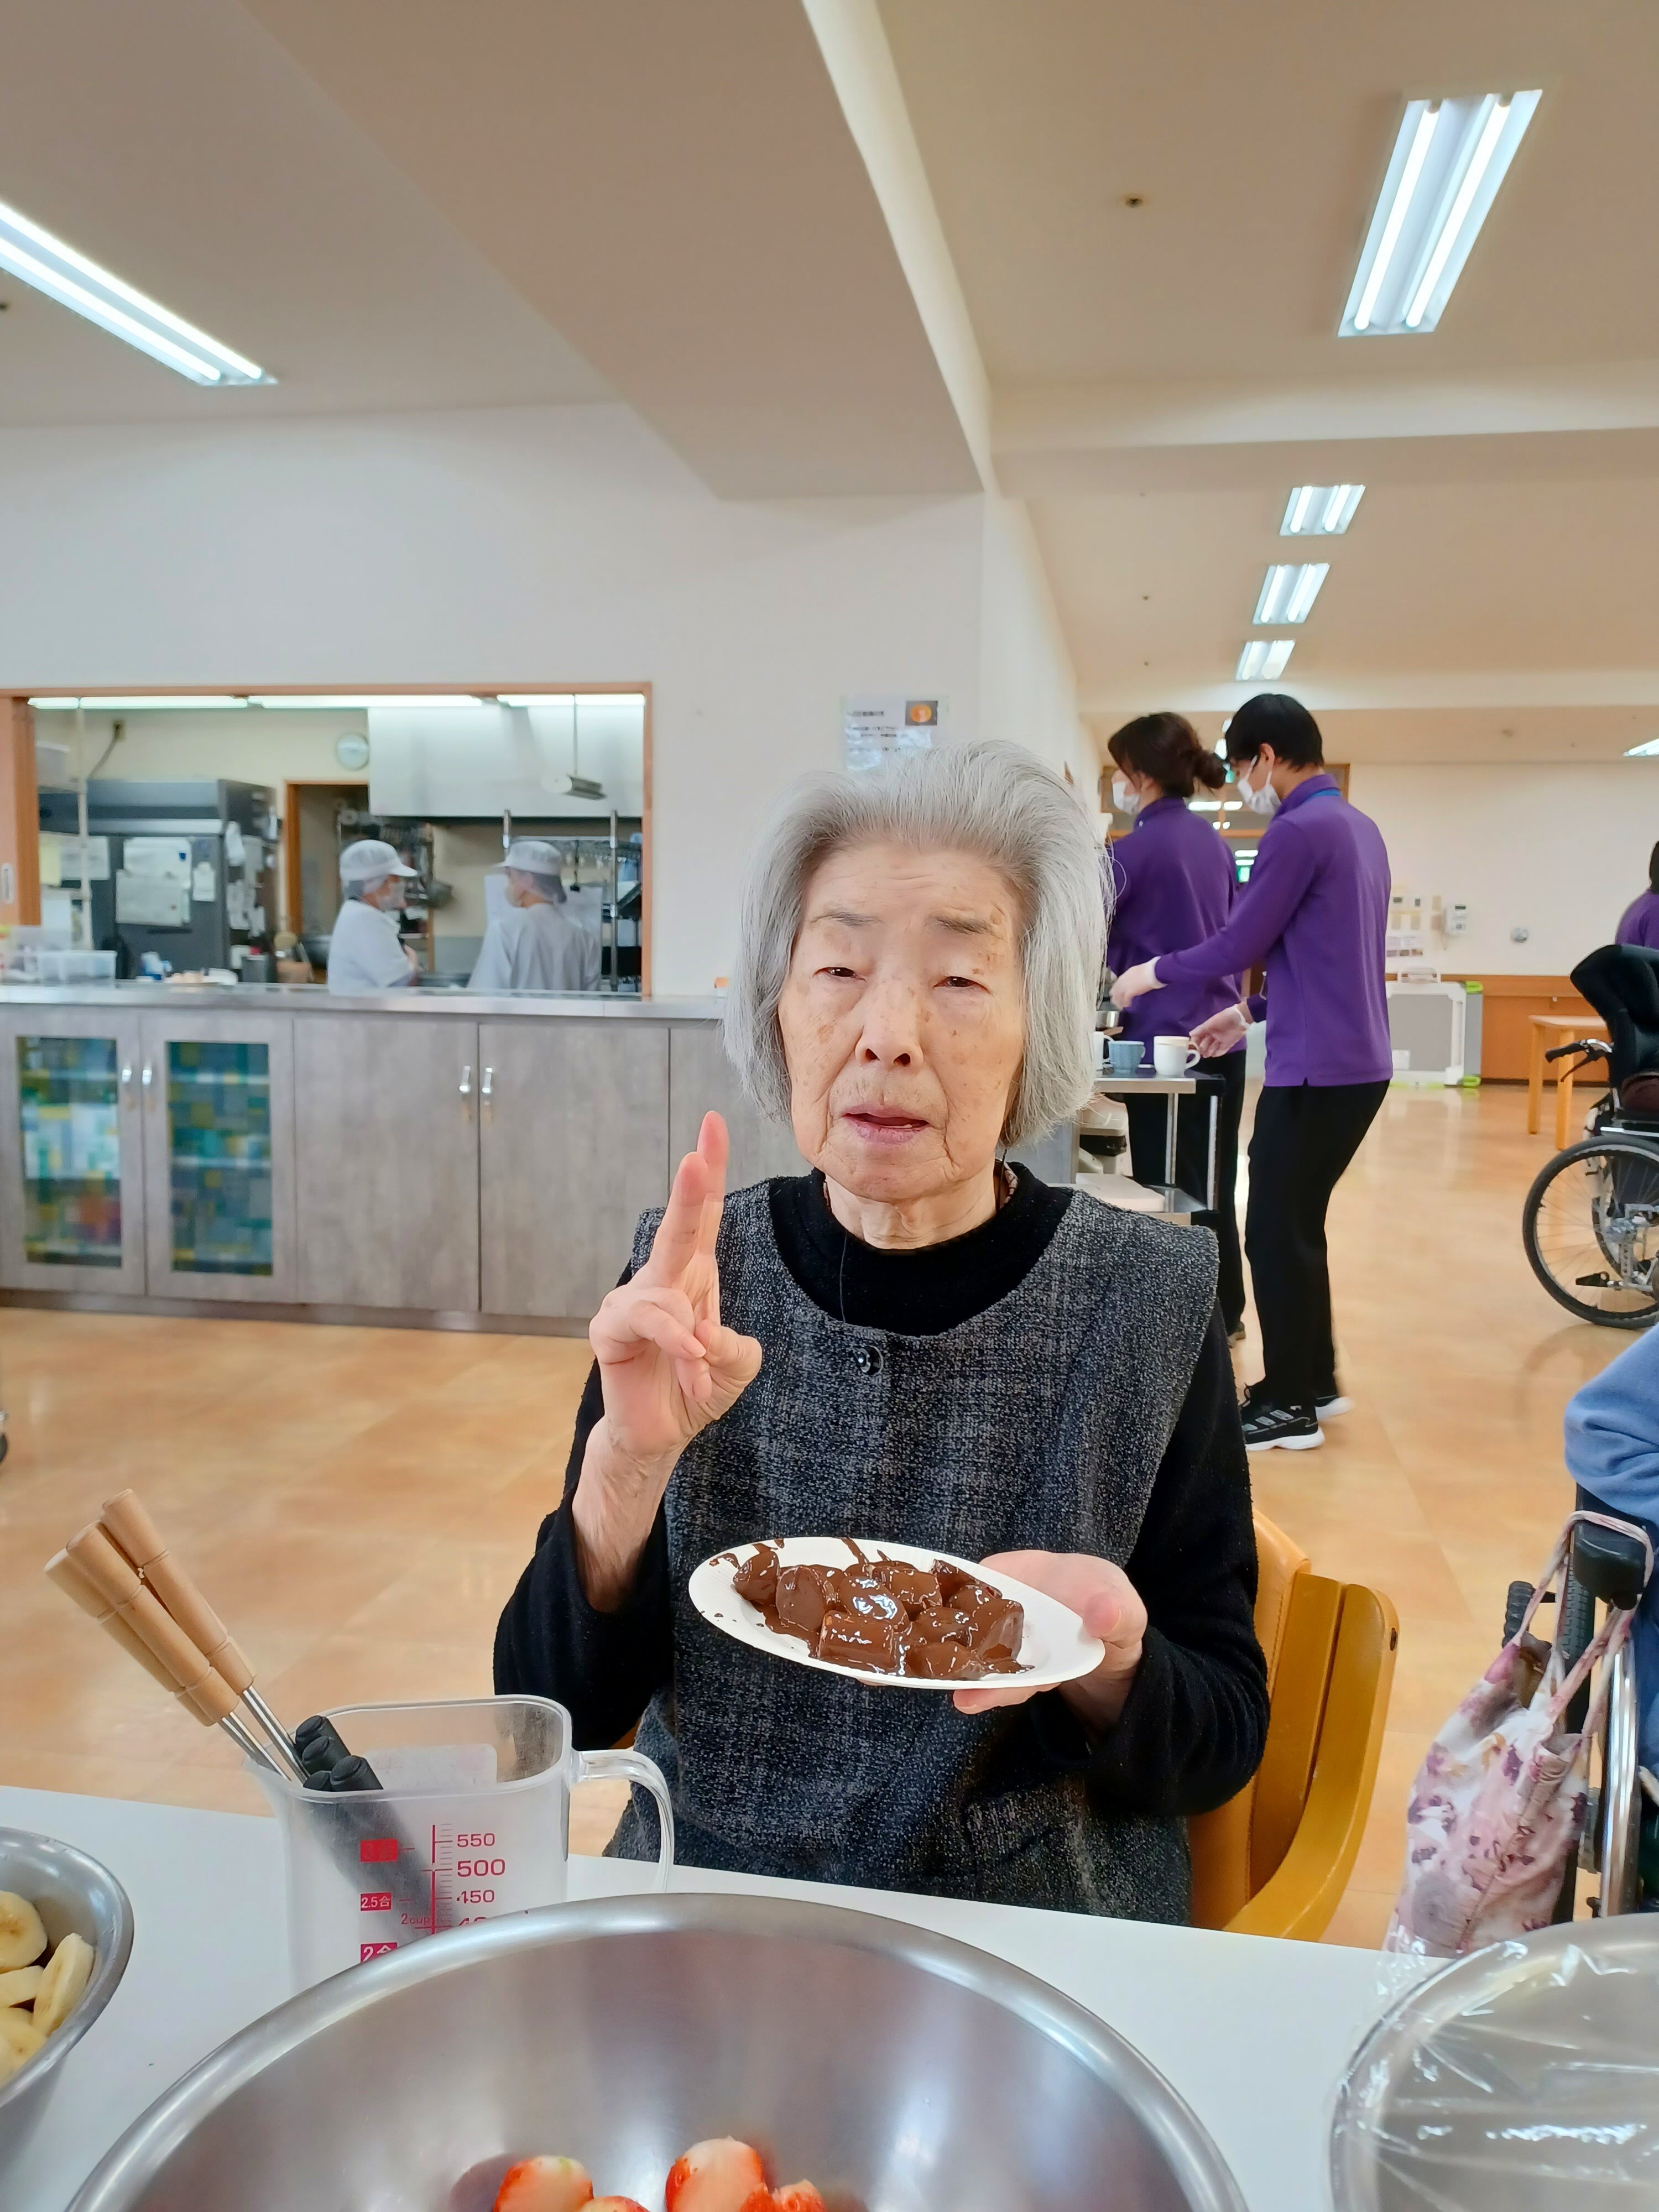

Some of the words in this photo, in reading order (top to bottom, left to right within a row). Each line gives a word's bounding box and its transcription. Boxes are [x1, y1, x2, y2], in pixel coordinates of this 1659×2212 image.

[457, 1833, 495, 1847] 550
[457, 1859, 505, 1877] 500
[361, 1895, 390, 1908] 2.5合
[456, 1890, 494, 1903] 450
